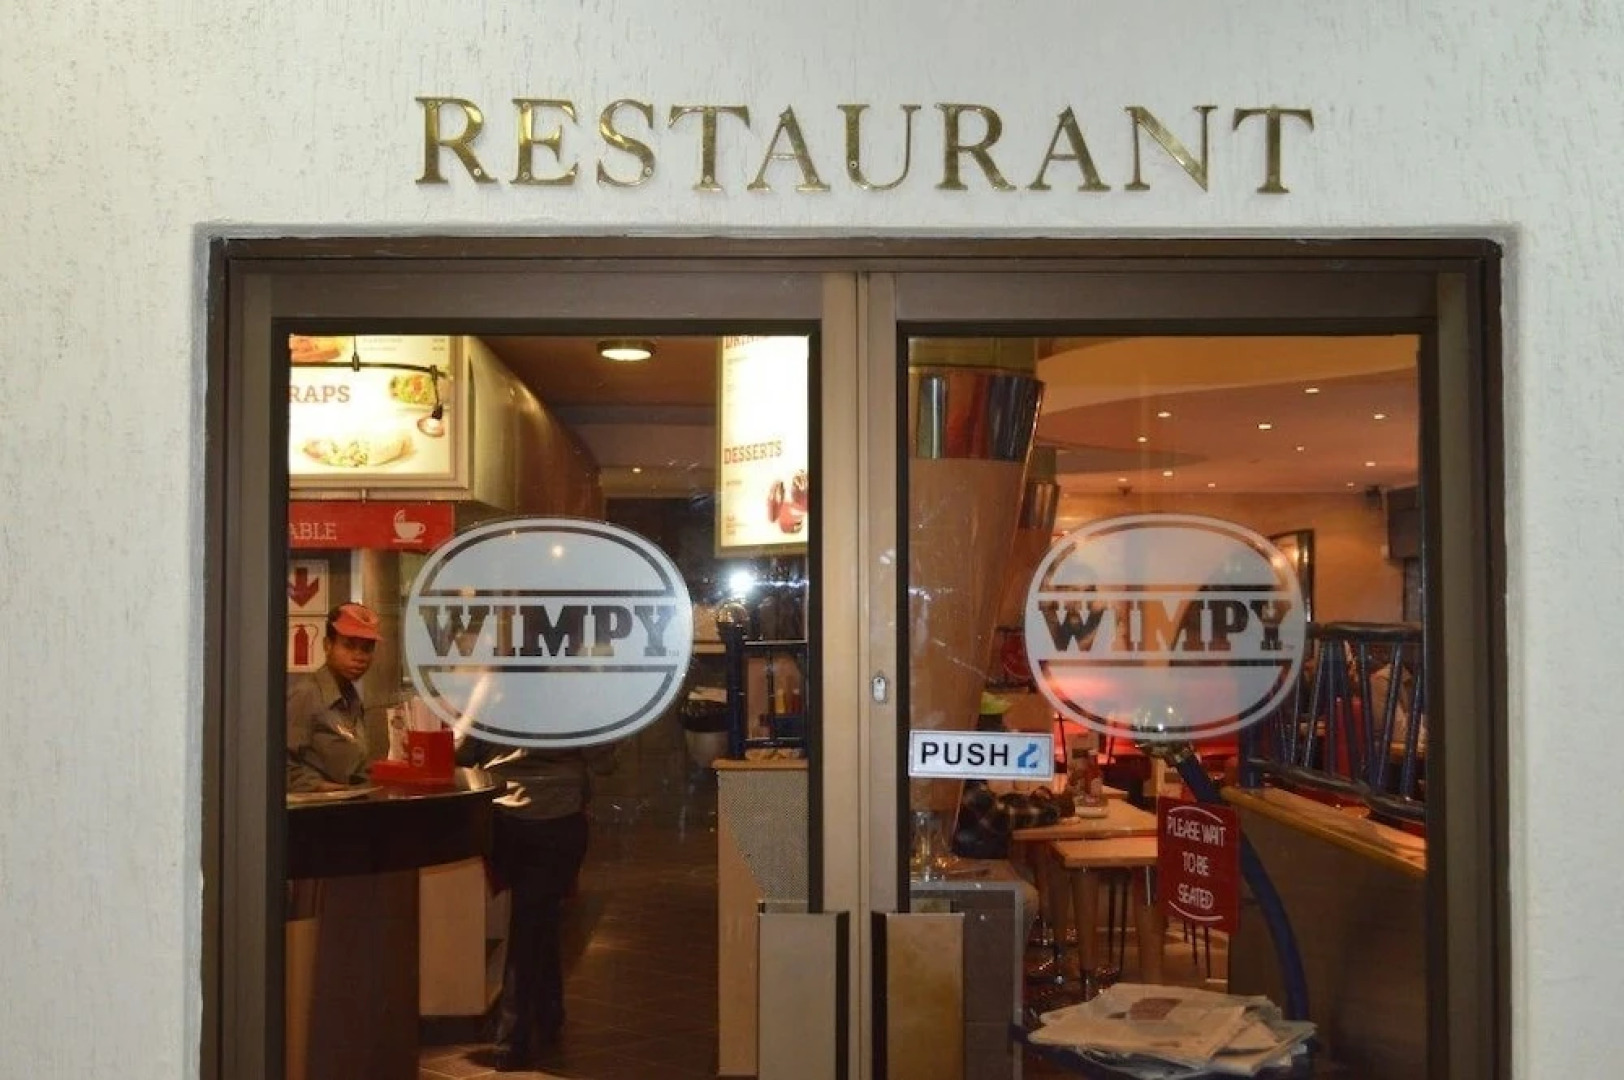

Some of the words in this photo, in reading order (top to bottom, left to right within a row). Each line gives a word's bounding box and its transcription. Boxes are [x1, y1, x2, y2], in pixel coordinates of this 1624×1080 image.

[414, 95, 1315, 194] RESTAURANT
[723, 440, 783, 465] DESSERTS
[418, 604, 677, 657] WIMPY
[1038, 599, 1292, 652] WIMPY
[920, 741, 1009, 767] PUSH
[1167, 816, 1200, 842] PLEASE
[1201, 824, 1227, 847] WAIT
[1182, 851, 1196, 874] TO
[1196, 855, 1209, 877] BE
[1177, 882, 1214, 909] SEATED
